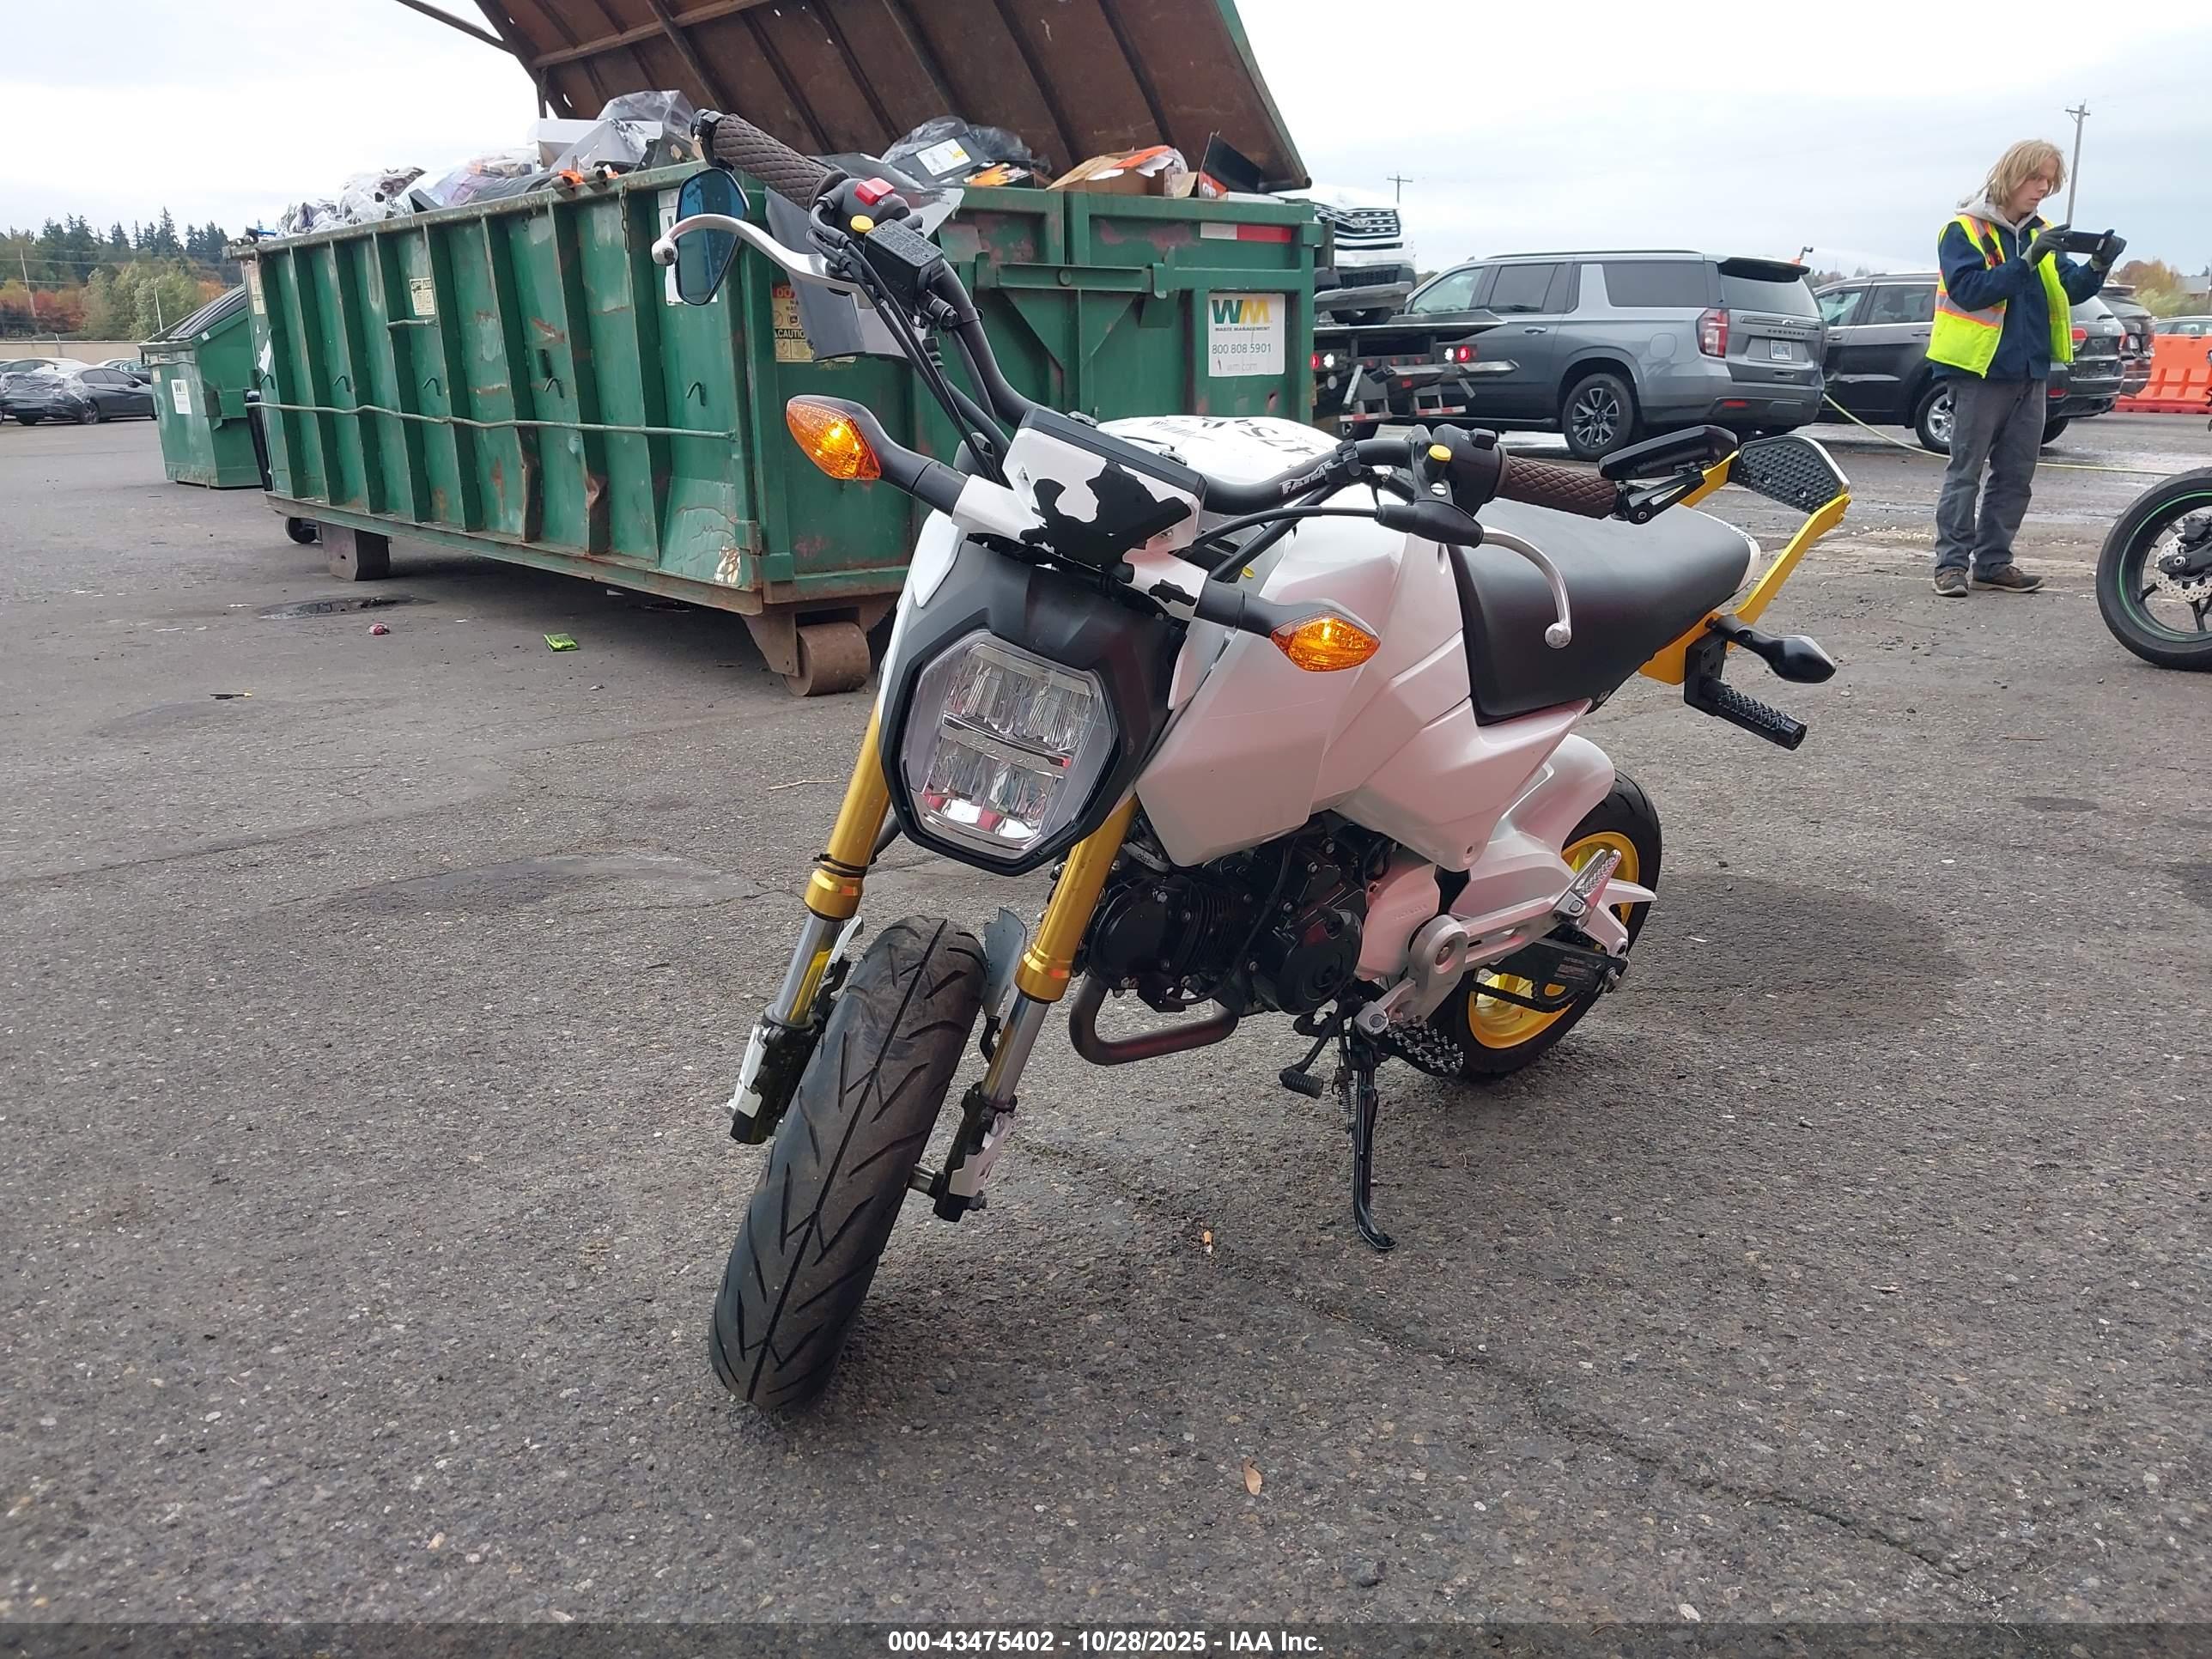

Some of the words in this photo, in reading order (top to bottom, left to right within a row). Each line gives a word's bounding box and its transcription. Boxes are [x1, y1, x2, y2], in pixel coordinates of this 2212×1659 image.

[1212, 299, 1270, 324] WM
[777, 329, 805, 338] CAUTIO
[1212, 344, 1229, 355] 800
[1231, 343, 1248, 354] 808
[1250, 343, 1271, 354] 5901
